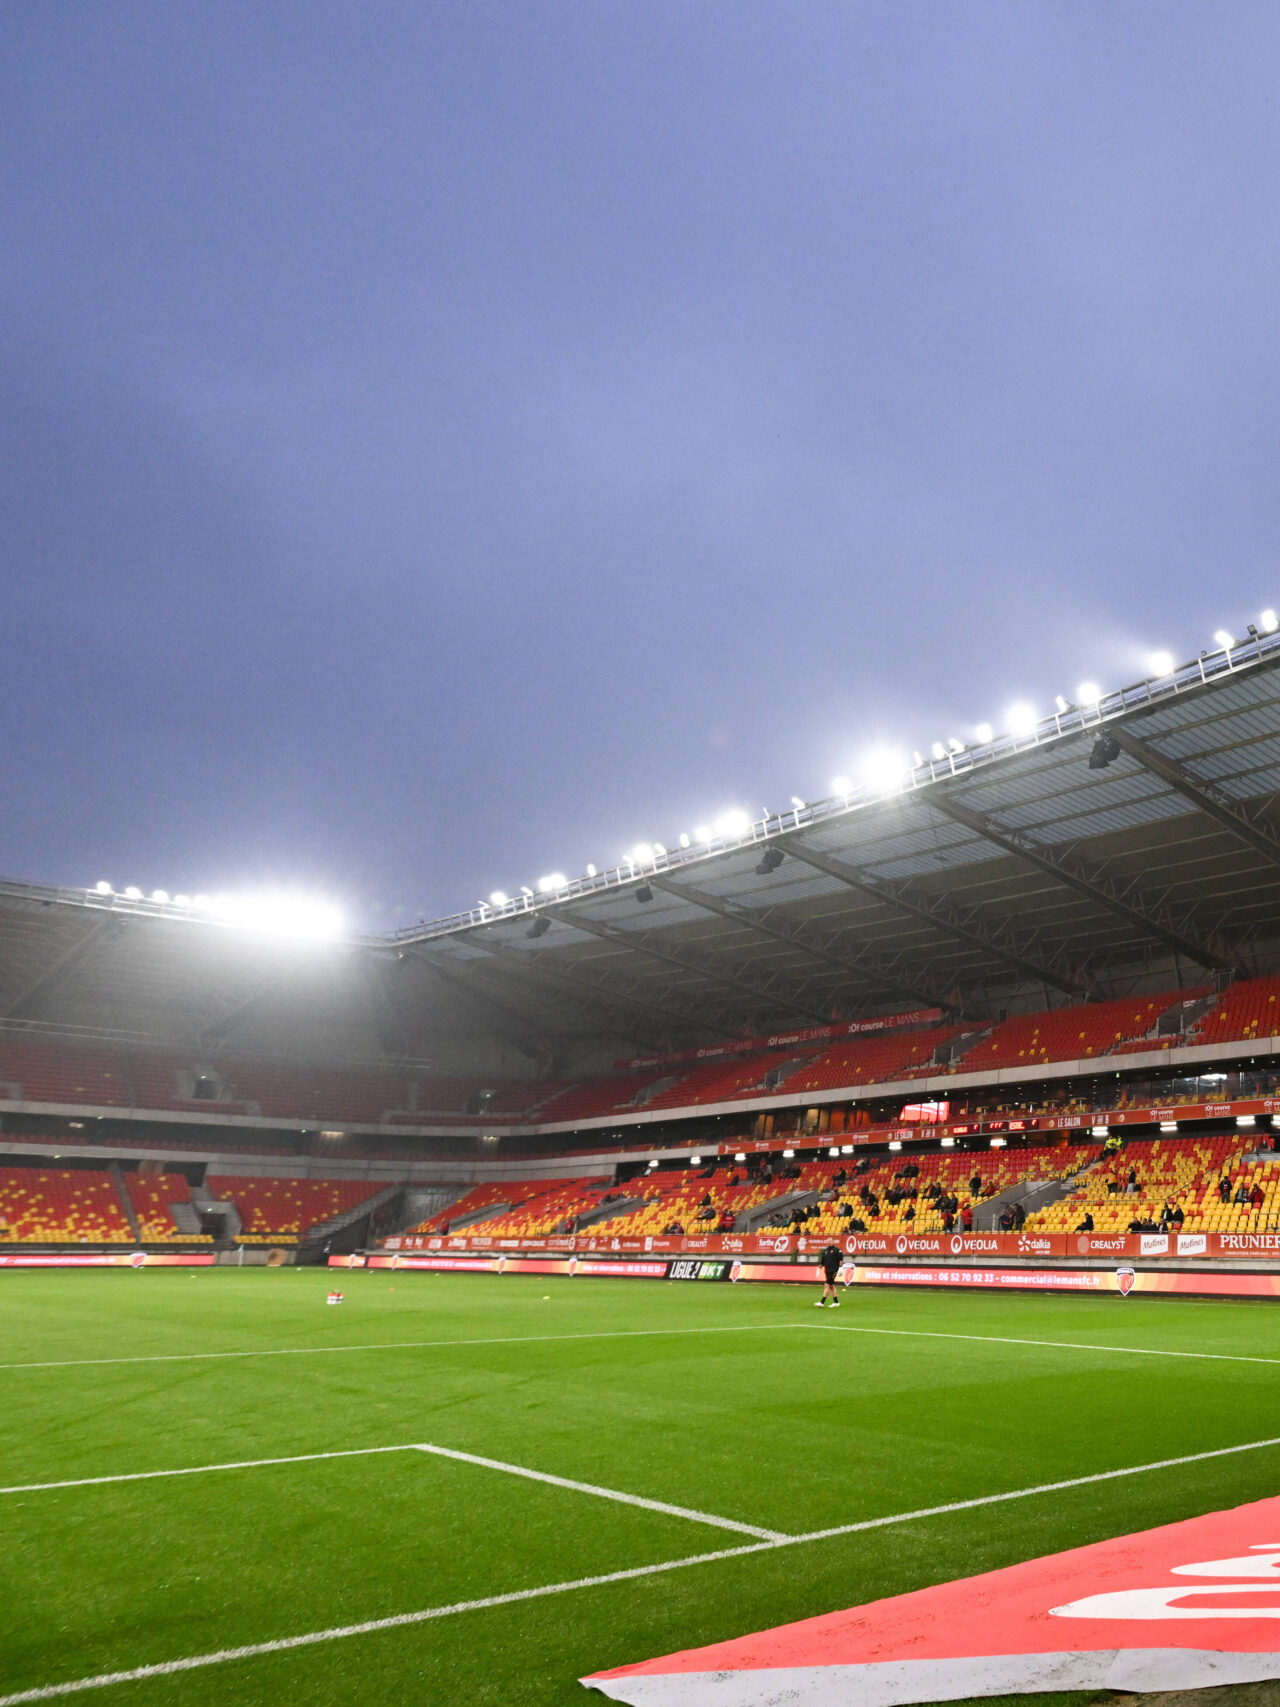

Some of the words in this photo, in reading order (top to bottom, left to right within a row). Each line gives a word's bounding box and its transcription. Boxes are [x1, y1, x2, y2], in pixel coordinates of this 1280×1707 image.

[861, 1022, 883, 1031] course
[885, 1017, 894, 1028] LE
[1058, 1118, 1063, 1127] LE
[1065, 1116, 1080, 1127] SALON
[857, 1240, 886, 1249] VEOLIA
[909, 1240, 939, 1250] VEOLIA
[964, 1240, 998, 1250] VEOLIA
[1031, 1239, 1050, 1249] dalkia
[1090, 1241, 1125, 1249] CREALYST
[669, 1261, 694, 1278] LIGUE
[691, 1262, 701, 1278] 2
[699, 1265, 724, 1276] BKT
[866, 1271, 881, 1279] Infos
[891, 1271, 932, 1280] réservations
[938, 1273, 948, 1281] 06
[951, 1273, 959, 1281] 52
[962, 1273, 971, 1281] 70
[973, 1274, 982, 1282] 92
[984, 1274, 994, 1282] 33
